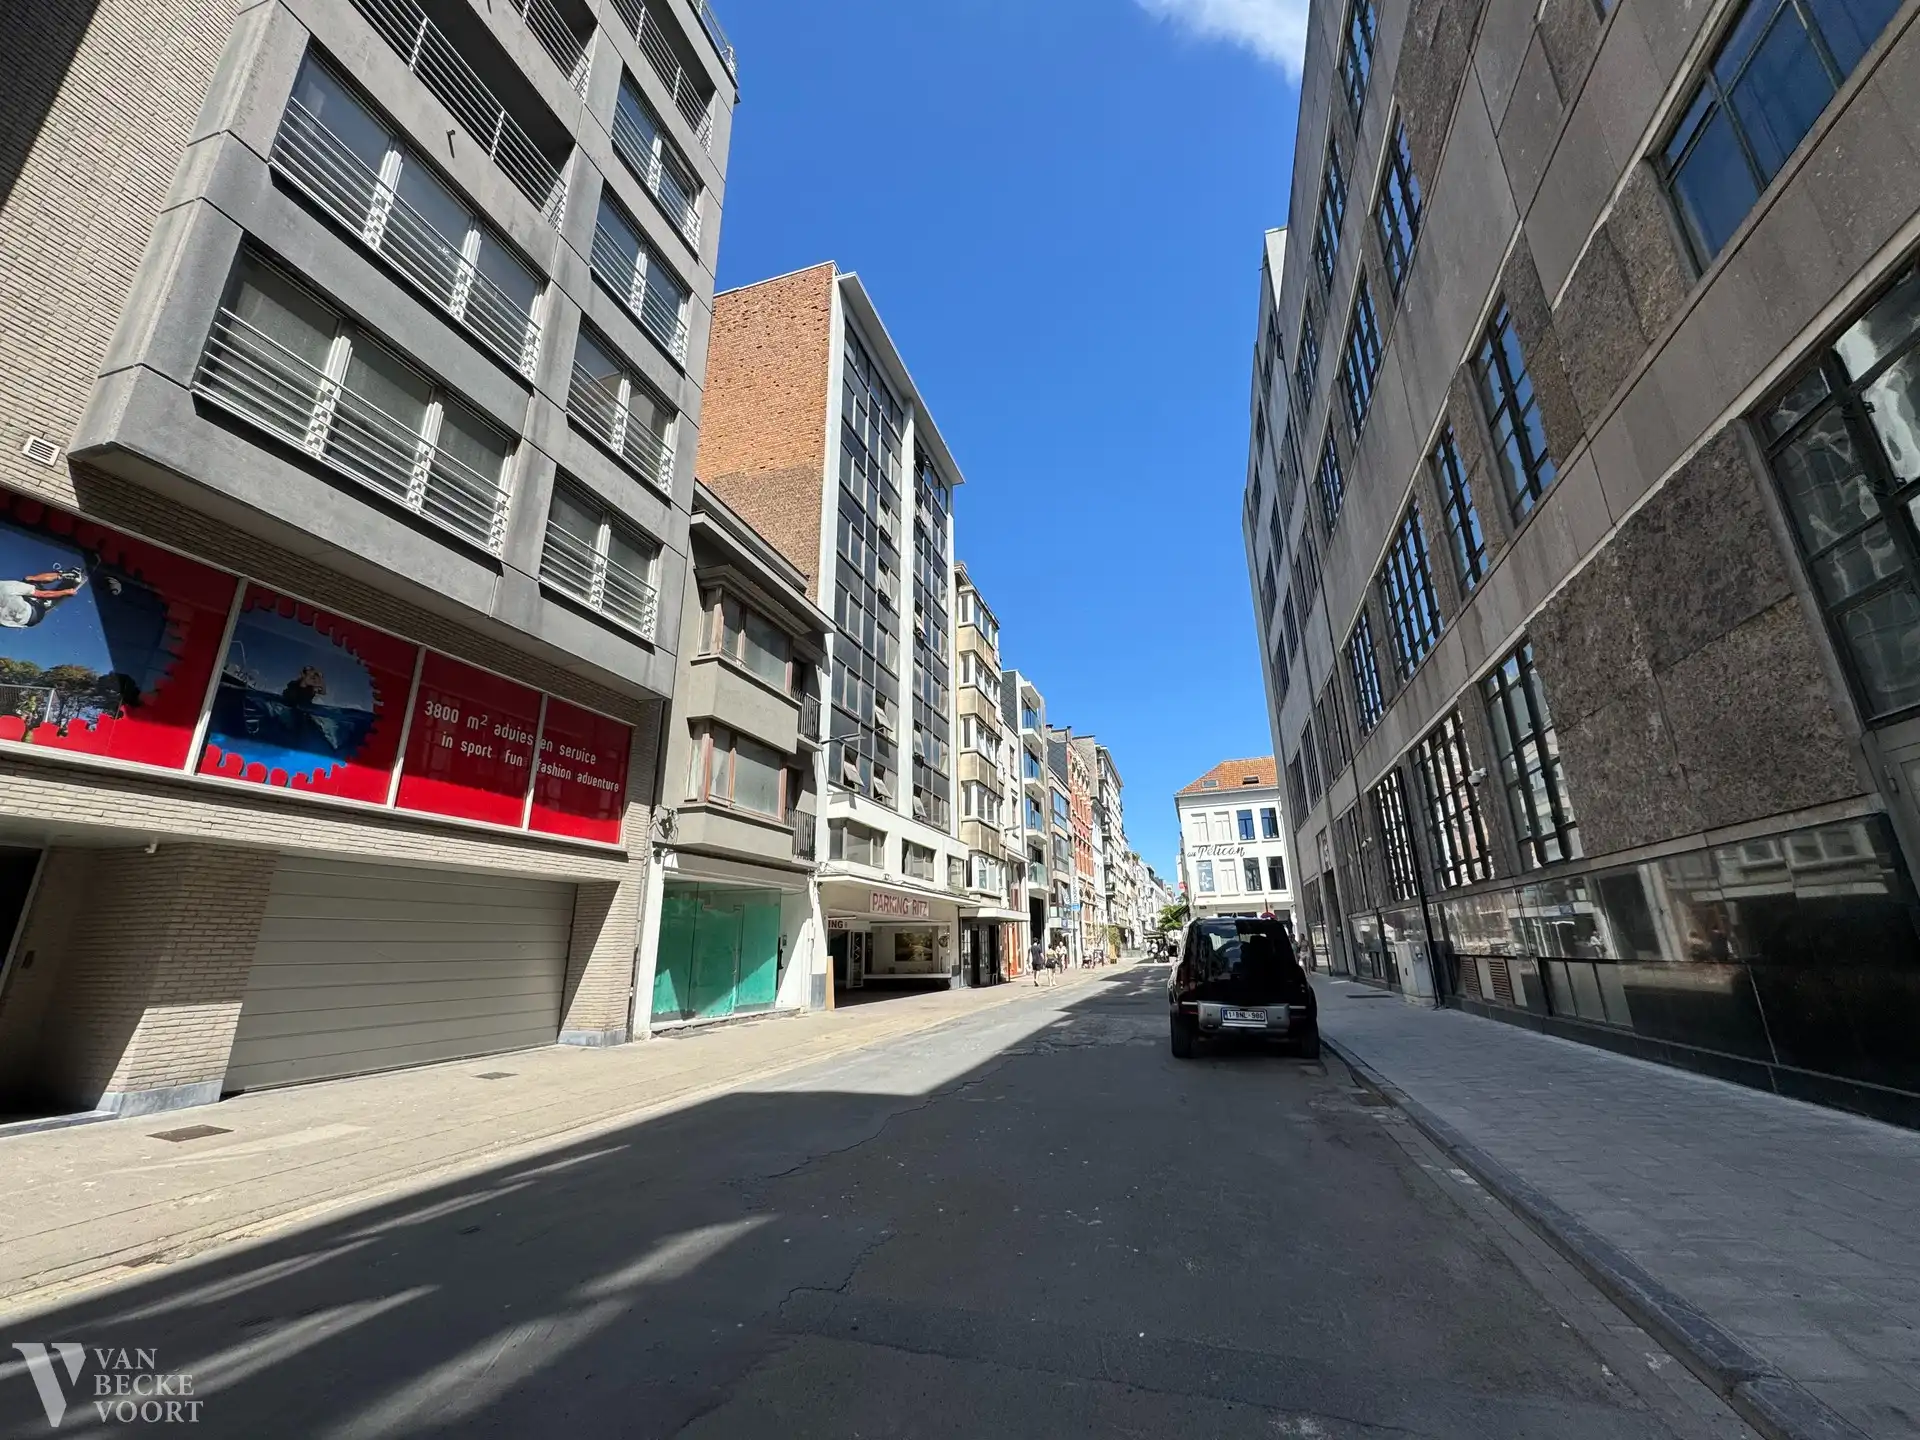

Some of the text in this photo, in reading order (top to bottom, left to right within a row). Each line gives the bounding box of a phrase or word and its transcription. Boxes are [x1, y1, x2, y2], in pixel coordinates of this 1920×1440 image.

[424, 700, 459, 724] 3800
[494, 723, 533, 746] advies
[540, 737, 553, 751] en
[559, 746, 597, 765] service
[441, 731, 620, 792] in sport fun fashion adventure
[872, 893, 929, 917] PARKING RITZ
